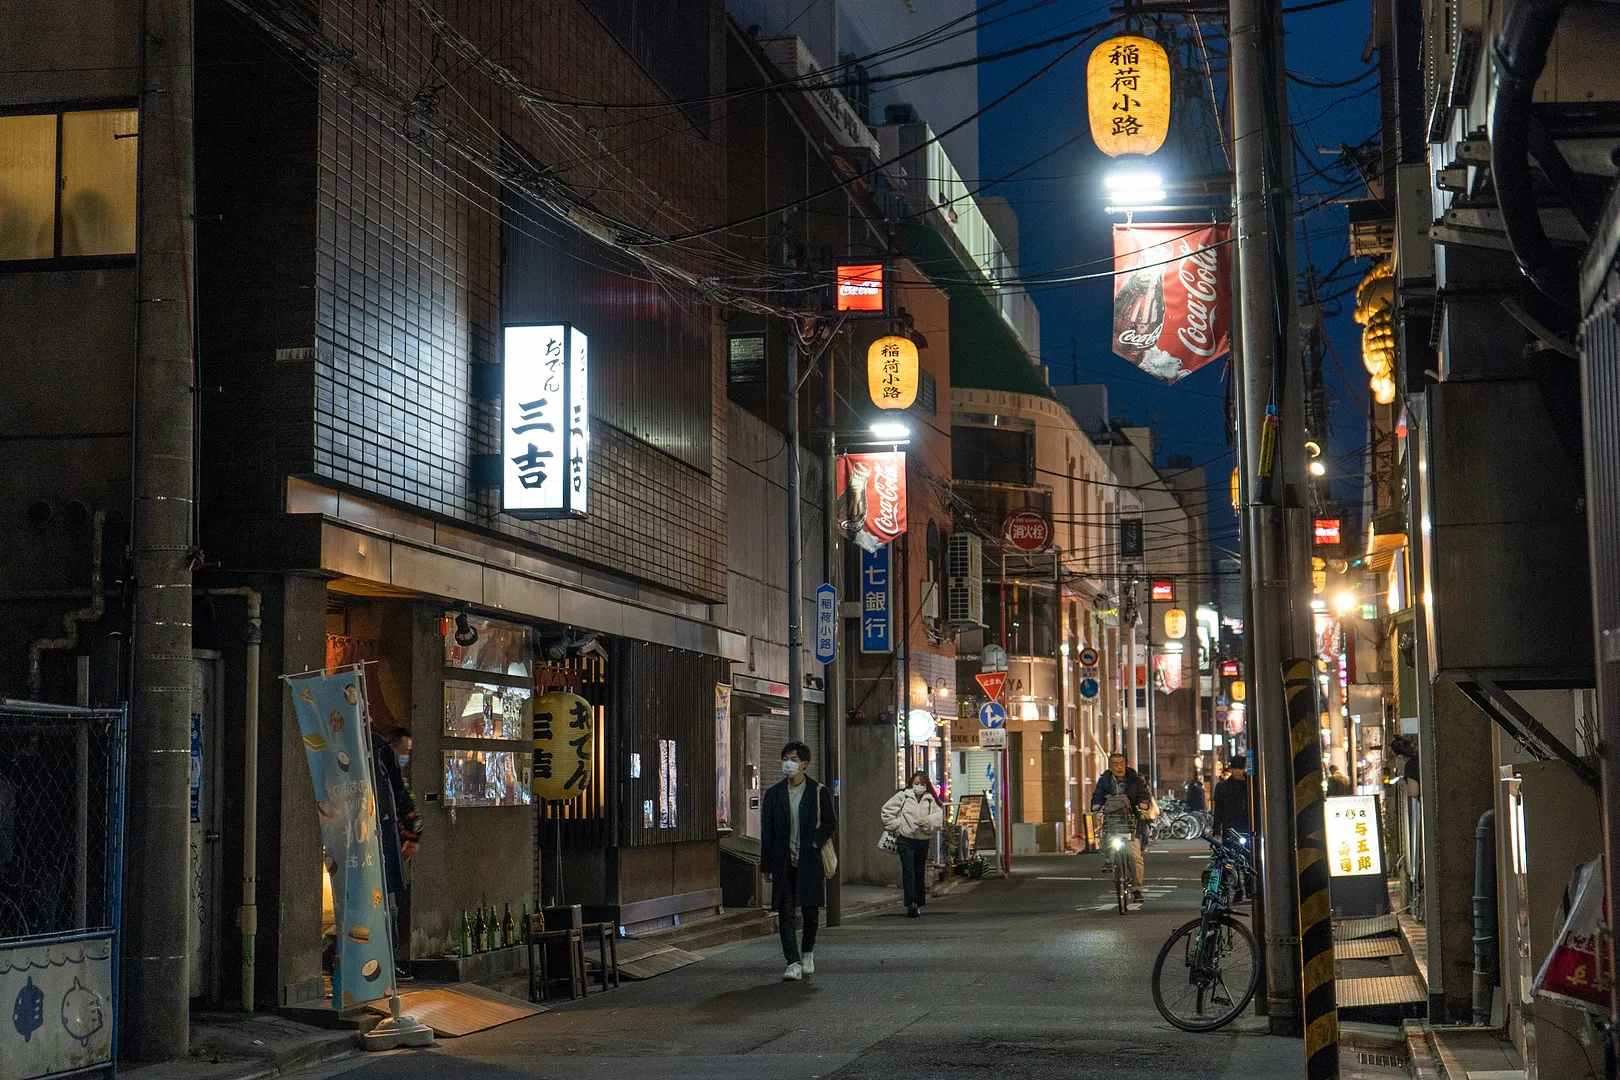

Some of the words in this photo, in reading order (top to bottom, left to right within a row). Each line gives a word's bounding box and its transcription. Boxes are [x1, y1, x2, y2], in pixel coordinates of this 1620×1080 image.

[1109, 44, 1143, 136] 稲荷小路
[1178, 239, 1217, 356] Coca-Cola
[544, 338, 565, 393] おでん
[881, 344, 901, 399] 稲荷小路
[511, 398, 556, 489] 三吉
[874, 462, 899, 535] Coca-Cola
[1013, 525, 1044, 539] 消火栓
[820, 599, 831, 649] 稲荷小路
[984, 678, 1002, 686] 止まれ
[1355, 822, 1372, 871] 与五郎
